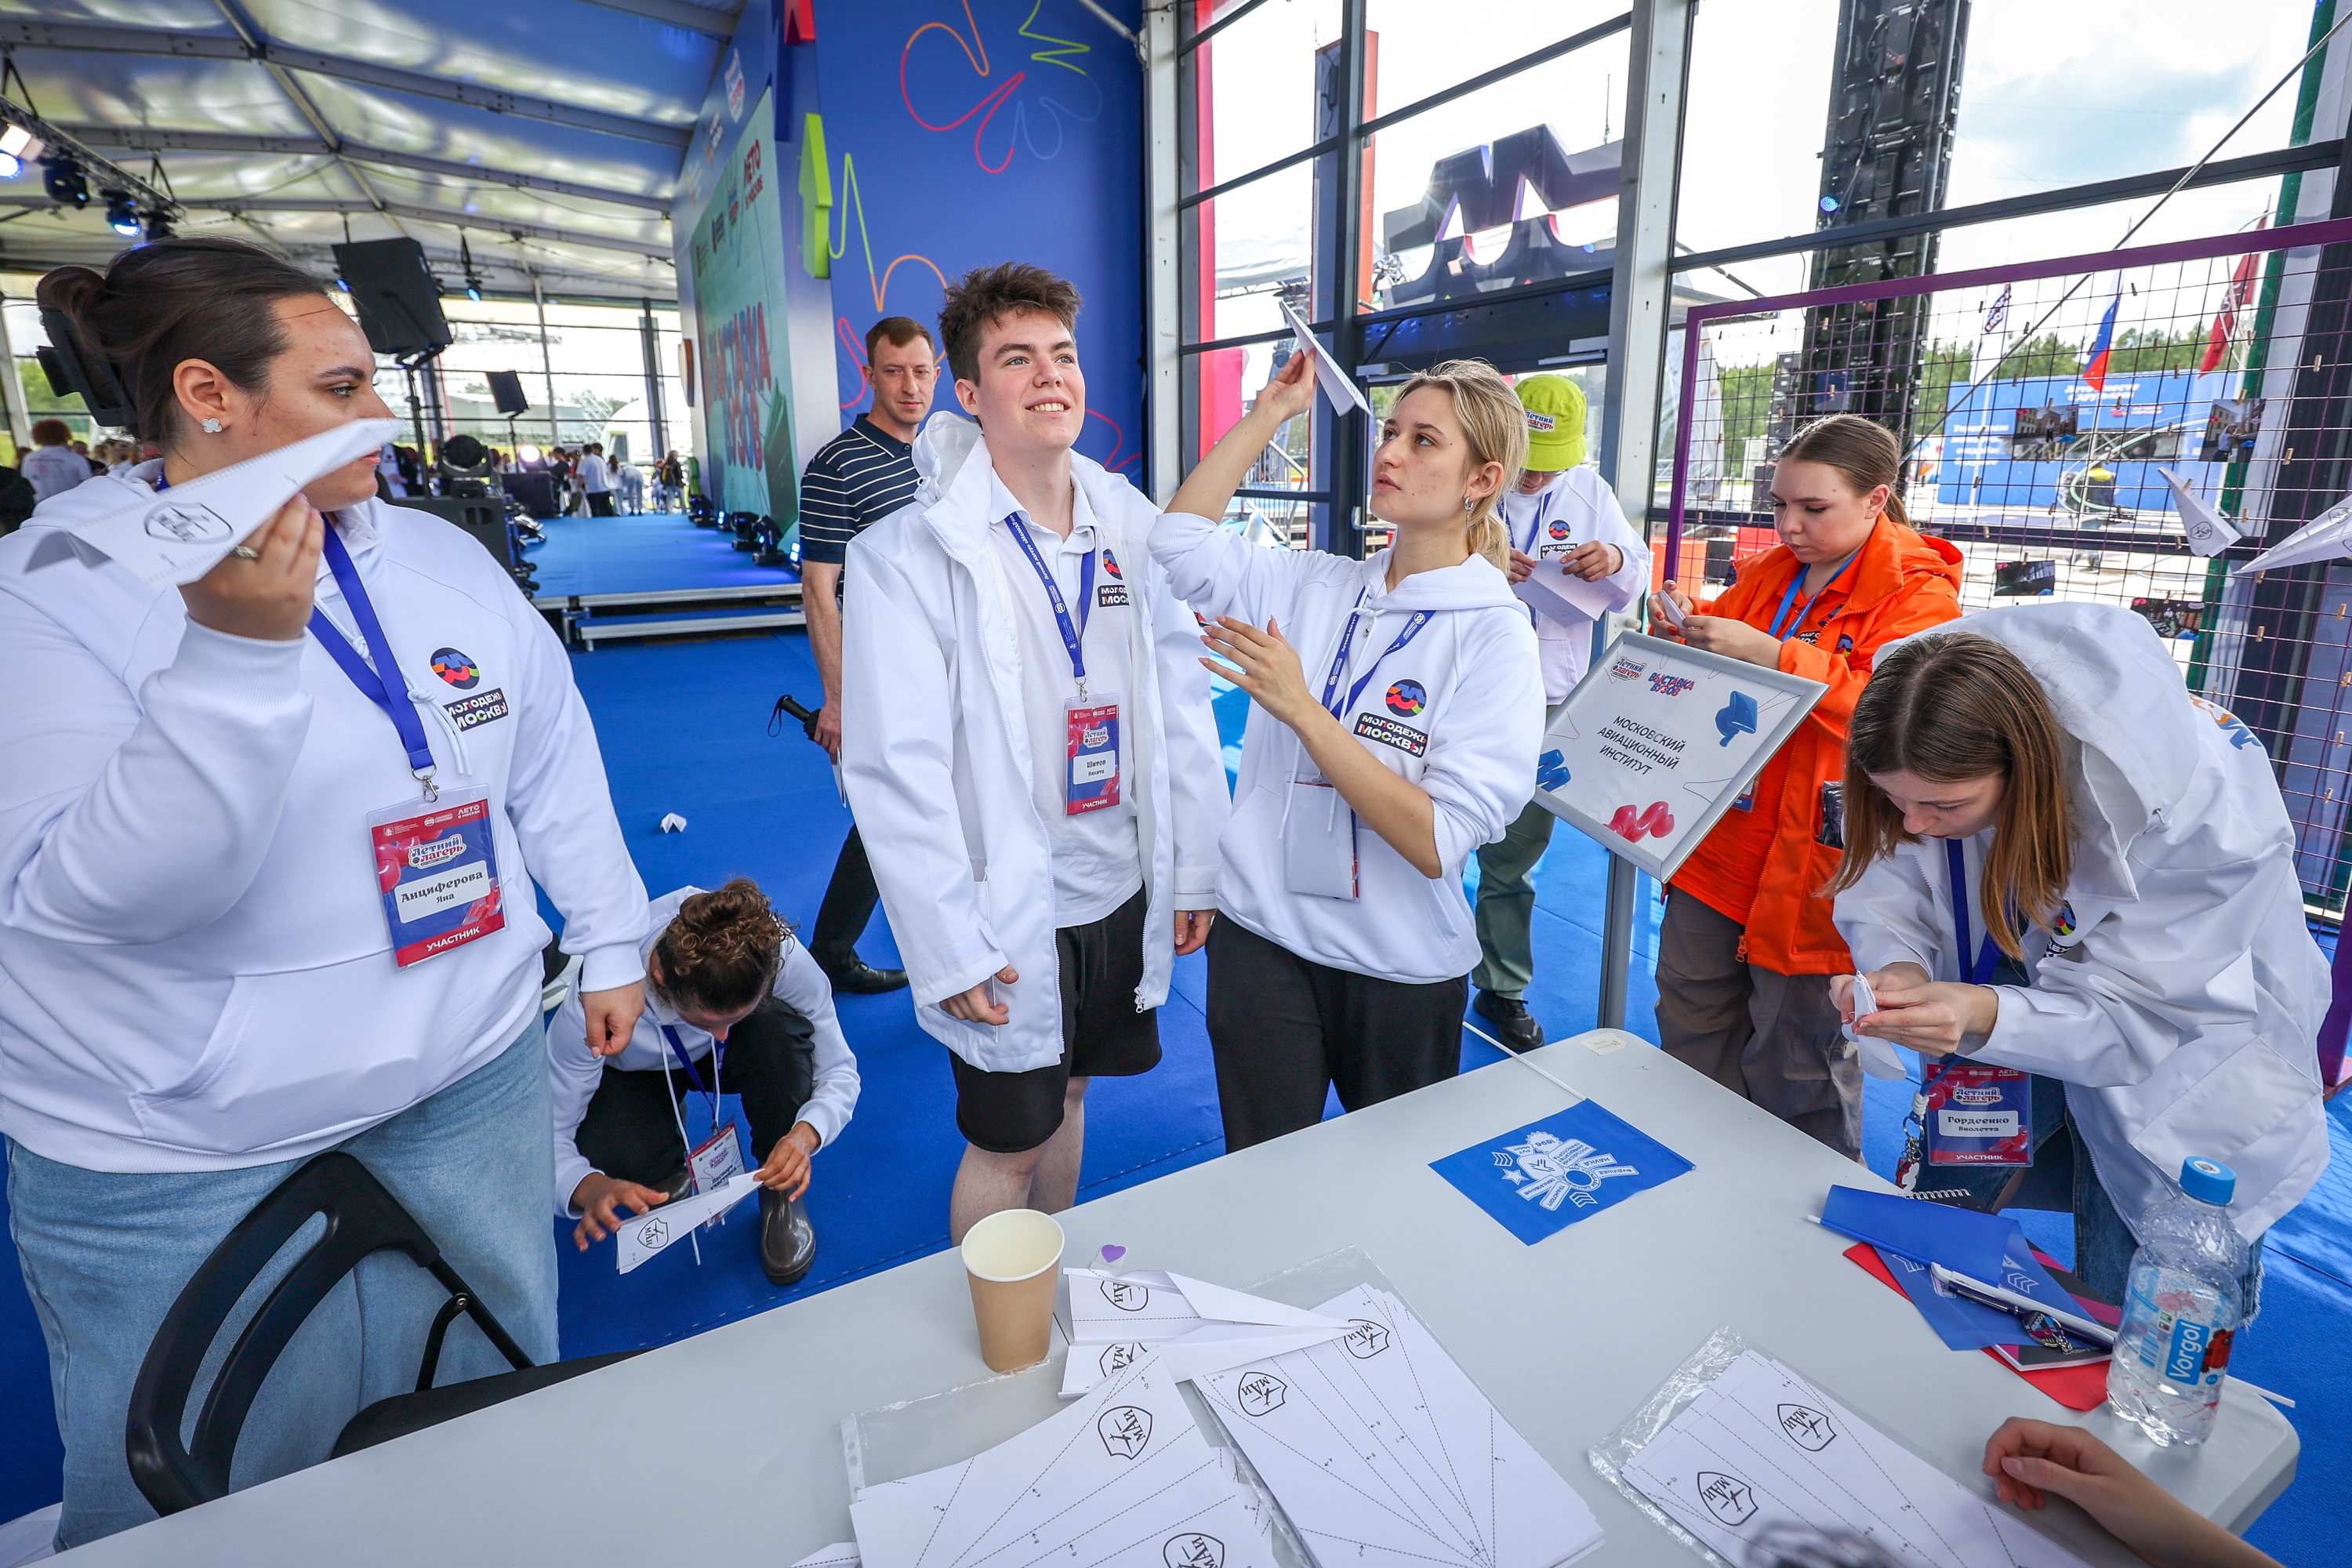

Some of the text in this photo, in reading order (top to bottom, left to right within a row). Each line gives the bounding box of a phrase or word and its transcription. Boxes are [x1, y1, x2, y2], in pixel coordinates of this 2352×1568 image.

[1526, 411, 1553, 424] Летний
[1528, 419, 1554, 430] лагерь
[1102, 595, 1129, 605] МОС
[1616, 666, 1639, 678] лагерь
[1617, 659, 1645, 673] Летний
[1648, 672, 1695, 691] ВЫСТАВКА
[1650, 682, 1681, 696] ВУЗОВ
[1085, 729, 1106, 738] Летний
[1362, 715, 1427, 743] МОЛОДЁЖЬ
[1613, 716, 1686, 753] МОСКОВСКИЙ
[1089, 735, 1108, 744] лагерь
[1358, 724, 1424, 755] МОСКВЫ
[1597, 727, 1680, 769] АВИАЦИОННЫЙ
[1087, 759, 1106, 768] Шитов
[1599, 745, 1653, 775] ИНСТИТУТ
[458, 804, 480, 815] ЛЕТО
[1082, 798, 1108, 809] УЧАСТНИК
[412, 837, 459, 858] Летний
[421, 846, 463, 862] лагерь
[400, 871, 484, 902] Анциферова
[436, 893, 455, 904] Яна
[426, 926, 481, 952] УЧАСТНИК
[1947, 1116, 2009, 1125] Гордеенко
[1583, 1157, 1610, 1167] НАУКА
[712, 1164, 733, 1184] Паспорт
[1547, 1185, 1565, 1207] ТРАНСПОРТ
[1113, 1283, 1131, 1303] АИ
[1347, 1323, 1374, 1341] МАИ
[2169, 1321, 2203, 1377] Vorgol
[1111, 1346, 1127, 1374] МА
[1241, 1376, 1271, 1398] МАИ
[1121, 1408, 1146, 1443] МАИ
[1784, 1407, 1809, 1431] МАИ
[1702, 1476, 1732, 1502] МАИ
[1190, 1536, 1218, 1568] МАИ
